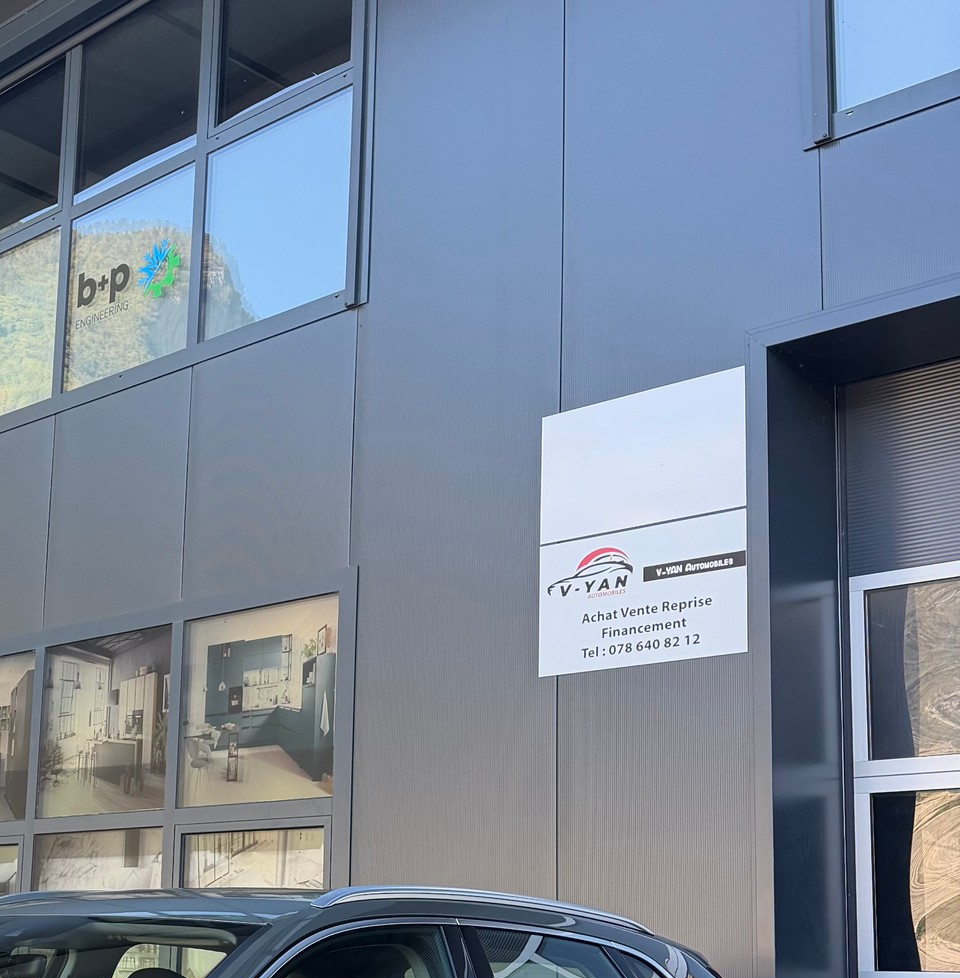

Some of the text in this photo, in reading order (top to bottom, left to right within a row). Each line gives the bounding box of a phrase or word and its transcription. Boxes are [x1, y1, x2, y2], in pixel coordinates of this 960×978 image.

[76, 262, 130, 309] b+p
[75, 300, 129, 330] ENGINEERING
[656, 564, 683, 577] V-YAN
[587, 588, 626, 600] AUTOMOBILES
[581, 596, 713, 625] Achat Vente Reprise
[601, 617, 687, 639] Financement
[608, 642, 632, 656] 078
[636, 638, 661, 652] 640
[664, 636, 680, 648] 82
[684, 633, 701, 646] 12
